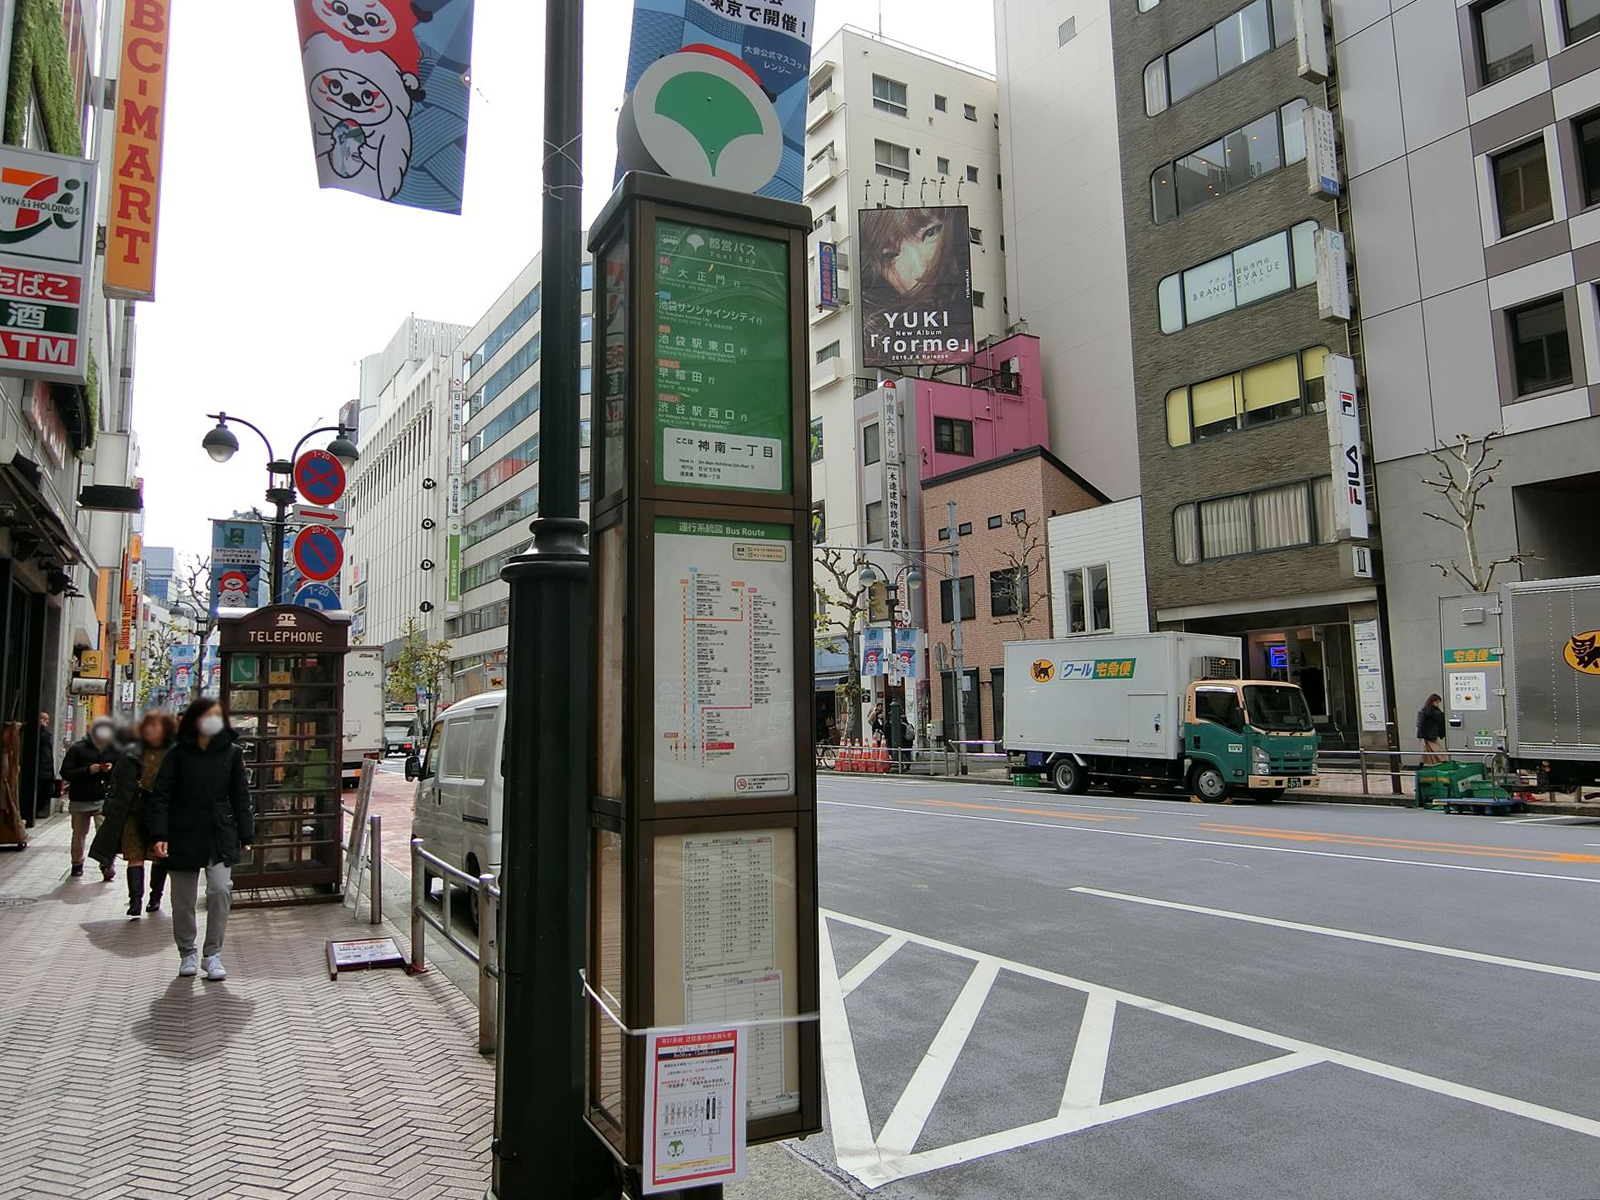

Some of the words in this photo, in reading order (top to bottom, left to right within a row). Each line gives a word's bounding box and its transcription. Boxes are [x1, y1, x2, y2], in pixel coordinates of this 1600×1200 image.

[700, 0, 807, 38] 東京で開催！
[744, 45, 808, 72] 大会公式マスコット
[764, 60, 792, 75] レンジー
[0, 196, 32, 208] VEN&i
[33, 201, 81, 216] HOLDINGS
[709, 237, 757, 256] 都営バス
[738, 256, 756, 265] Bus
[7, 302, 48, 329] 酒
[883, 310, 949, 329] YUKI
[453, 393, 461, 431] 日本生命
[675, 437, 694, 445] ここは
[698, 439, 774, 459] 神南一丁目
[1346, 444, 1362, 506] FILA
[888, 471, 900, 549] 木造建物診断協会
[678, 521, 724, 534] 運行系統図
[725, 527, 741, 535] Bus
[742, 527, 766, 537] Route
[249, 631, 323, 643] TELEPHONE
[1453, 648, 1489, 662] 宅急便
